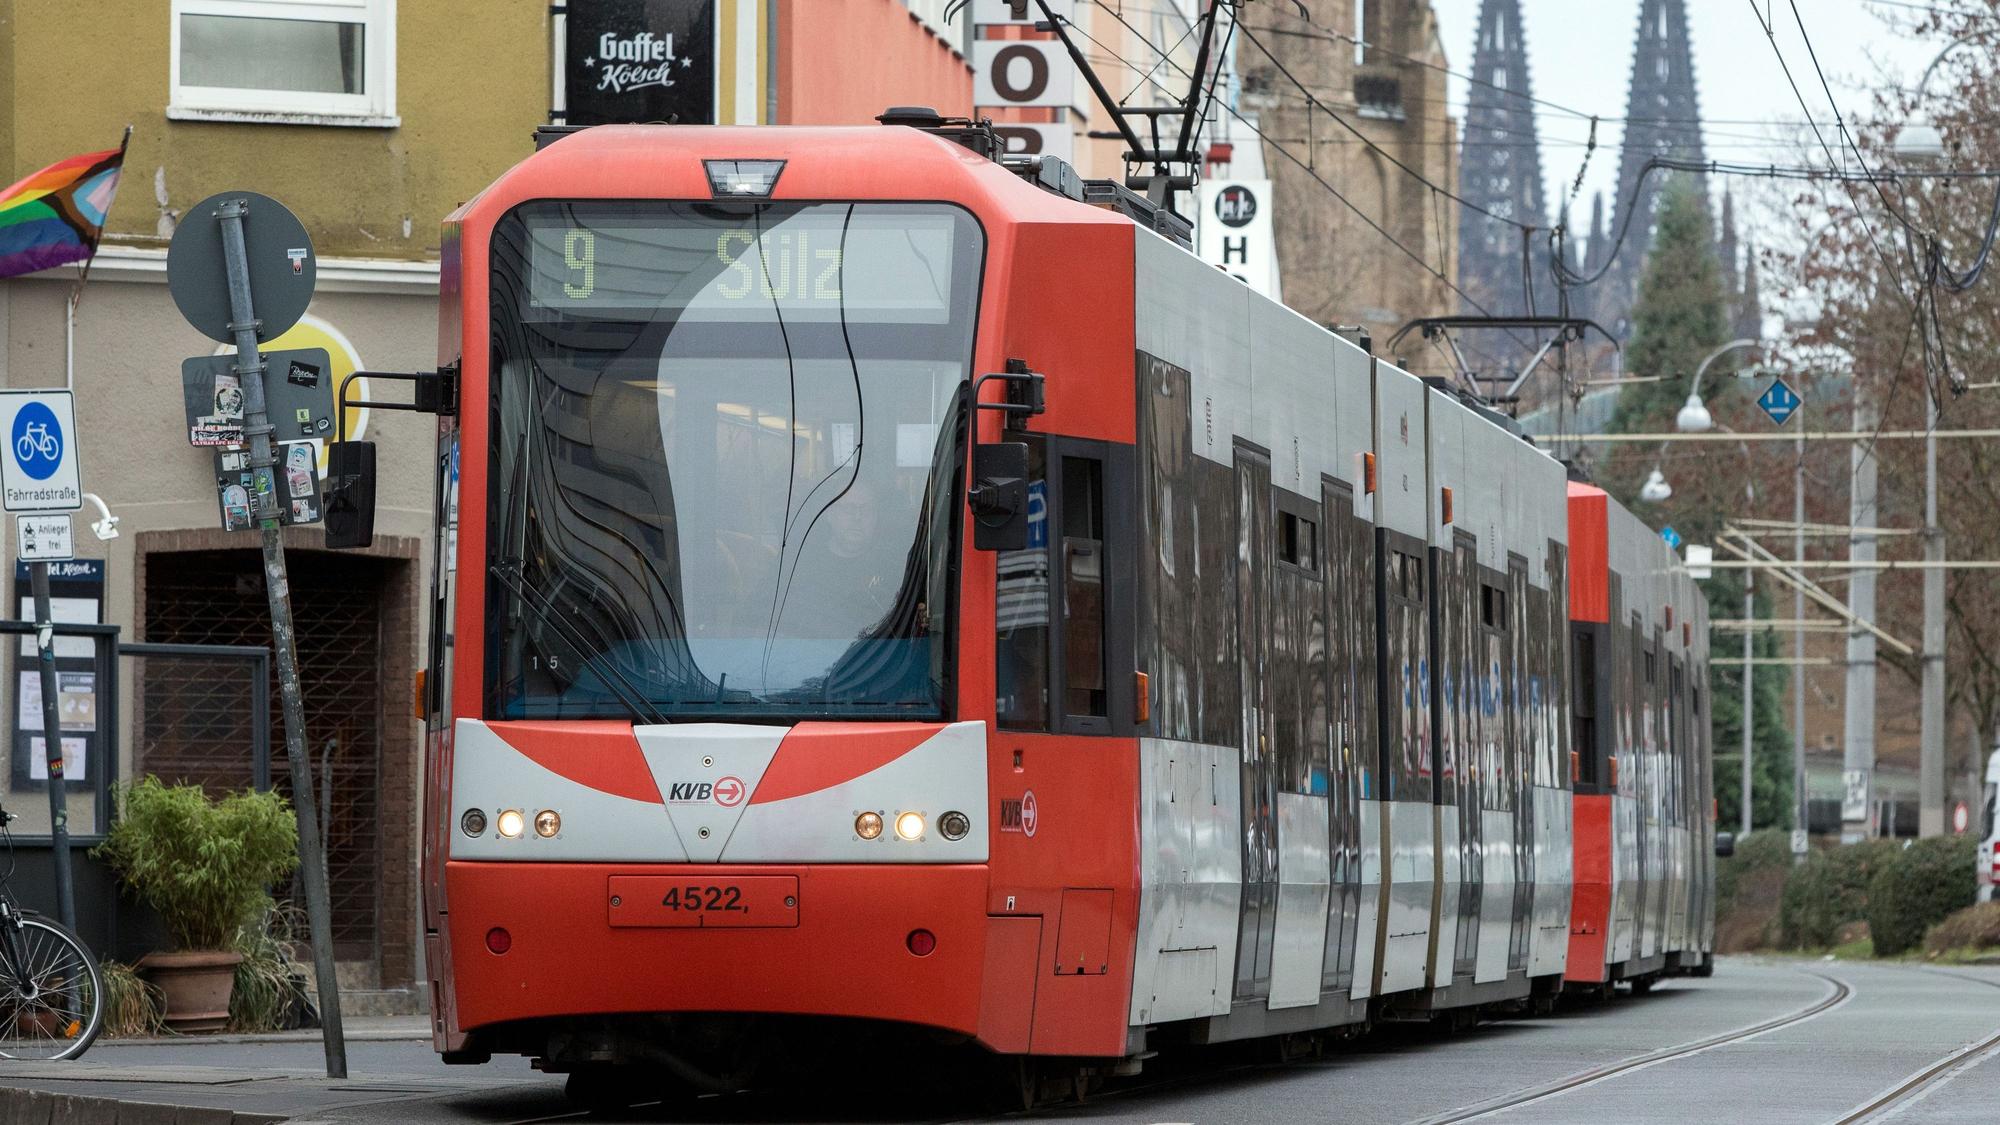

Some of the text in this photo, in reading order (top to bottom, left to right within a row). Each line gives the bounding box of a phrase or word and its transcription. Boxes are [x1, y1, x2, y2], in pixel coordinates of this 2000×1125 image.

[600, 32, 676, 63] Gaffel
[597, 61, 675, 93] Kölsch
[564, 229, 843, 300] 9 Sülz
[7, 487, 76, 501] Fahrradstraße
[38, 525, 67, 535] Anlieger
[48, 539, 61, 550] frei
[669, 783, 712, 800] KVB
[1001, 800, 1021, 827] KVB
